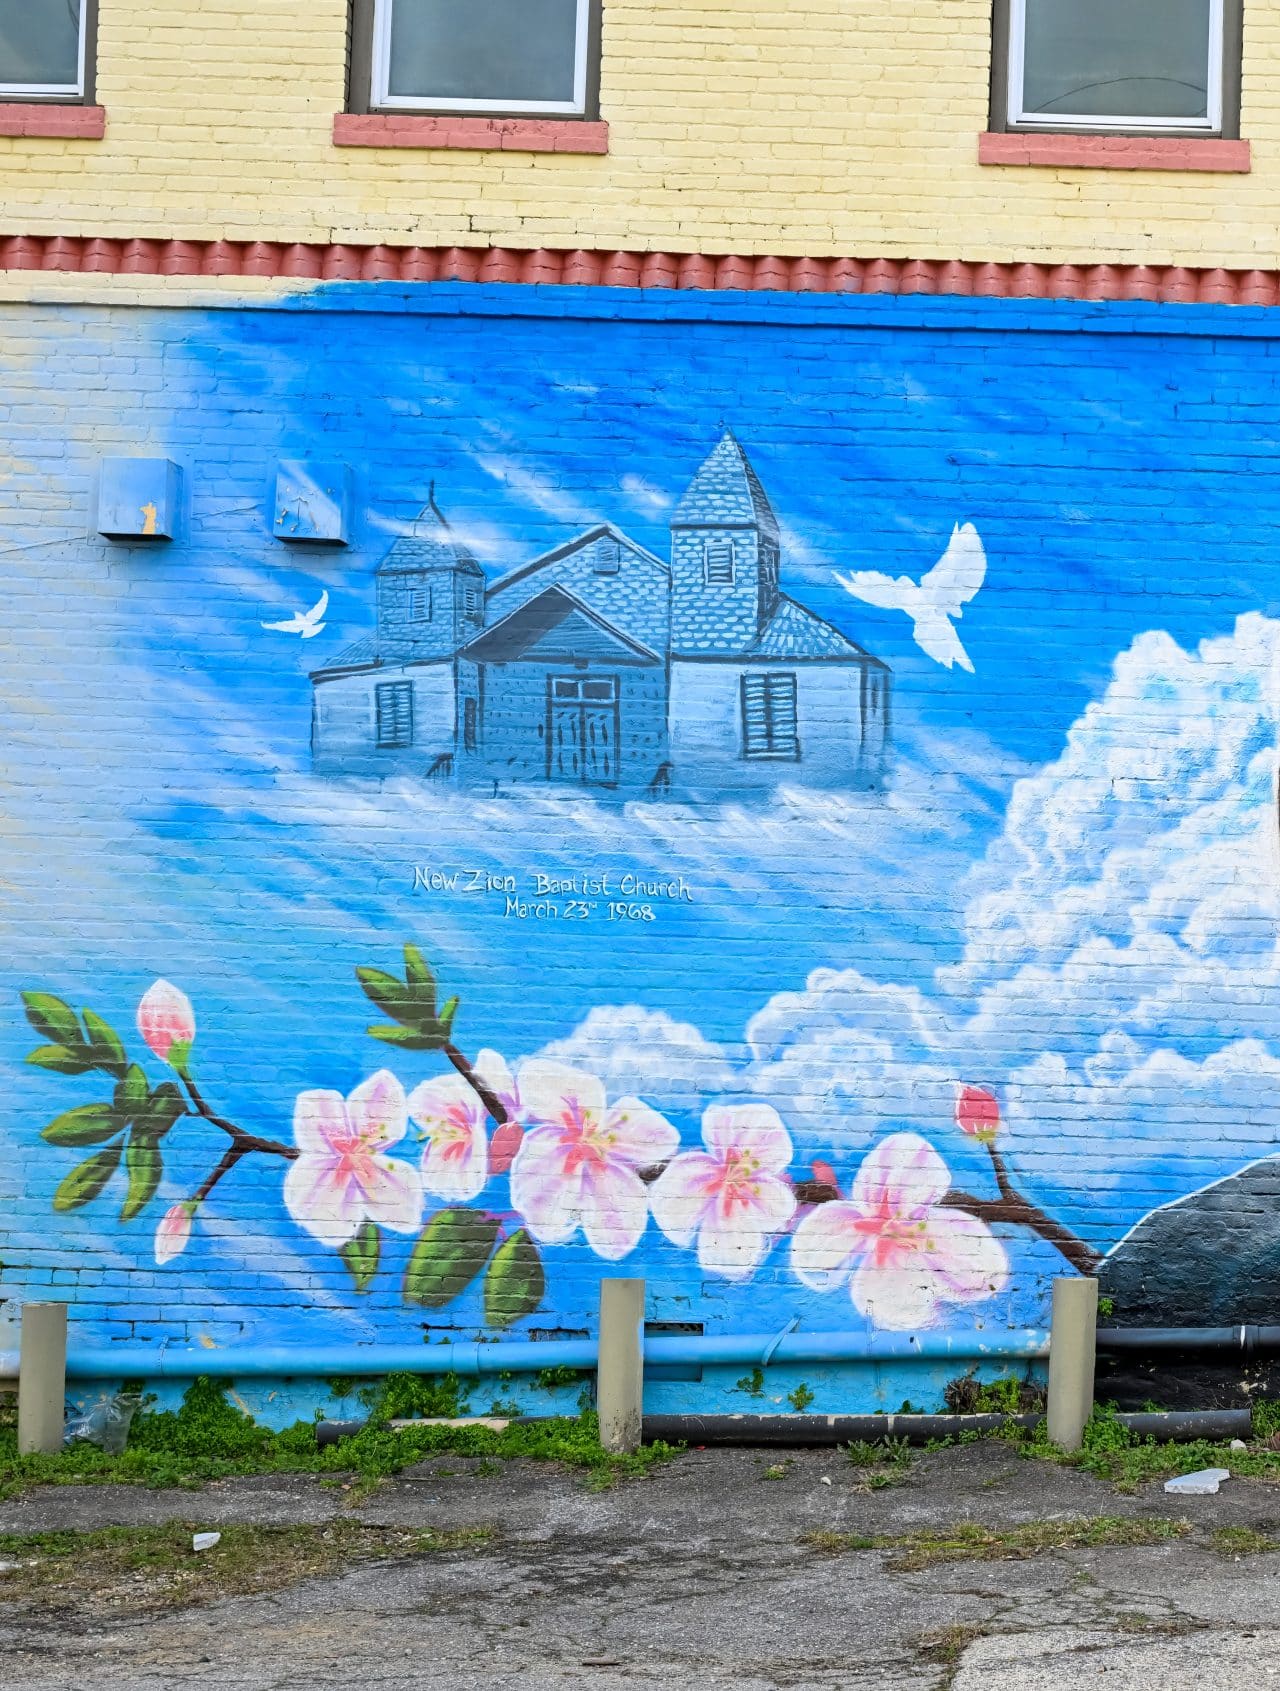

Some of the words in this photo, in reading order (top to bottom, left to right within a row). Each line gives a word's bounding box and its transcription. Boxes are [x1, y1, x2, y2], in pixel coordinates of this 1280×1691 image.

[412, 866, 459, 891] New
[462, 868, 516, 893] Zion
[531, 872, 611, 897] Baptist
[619, 874, 694, 902] Church
[504, 896, 557, 920] March
[607, 901, 656, 922] 1968
